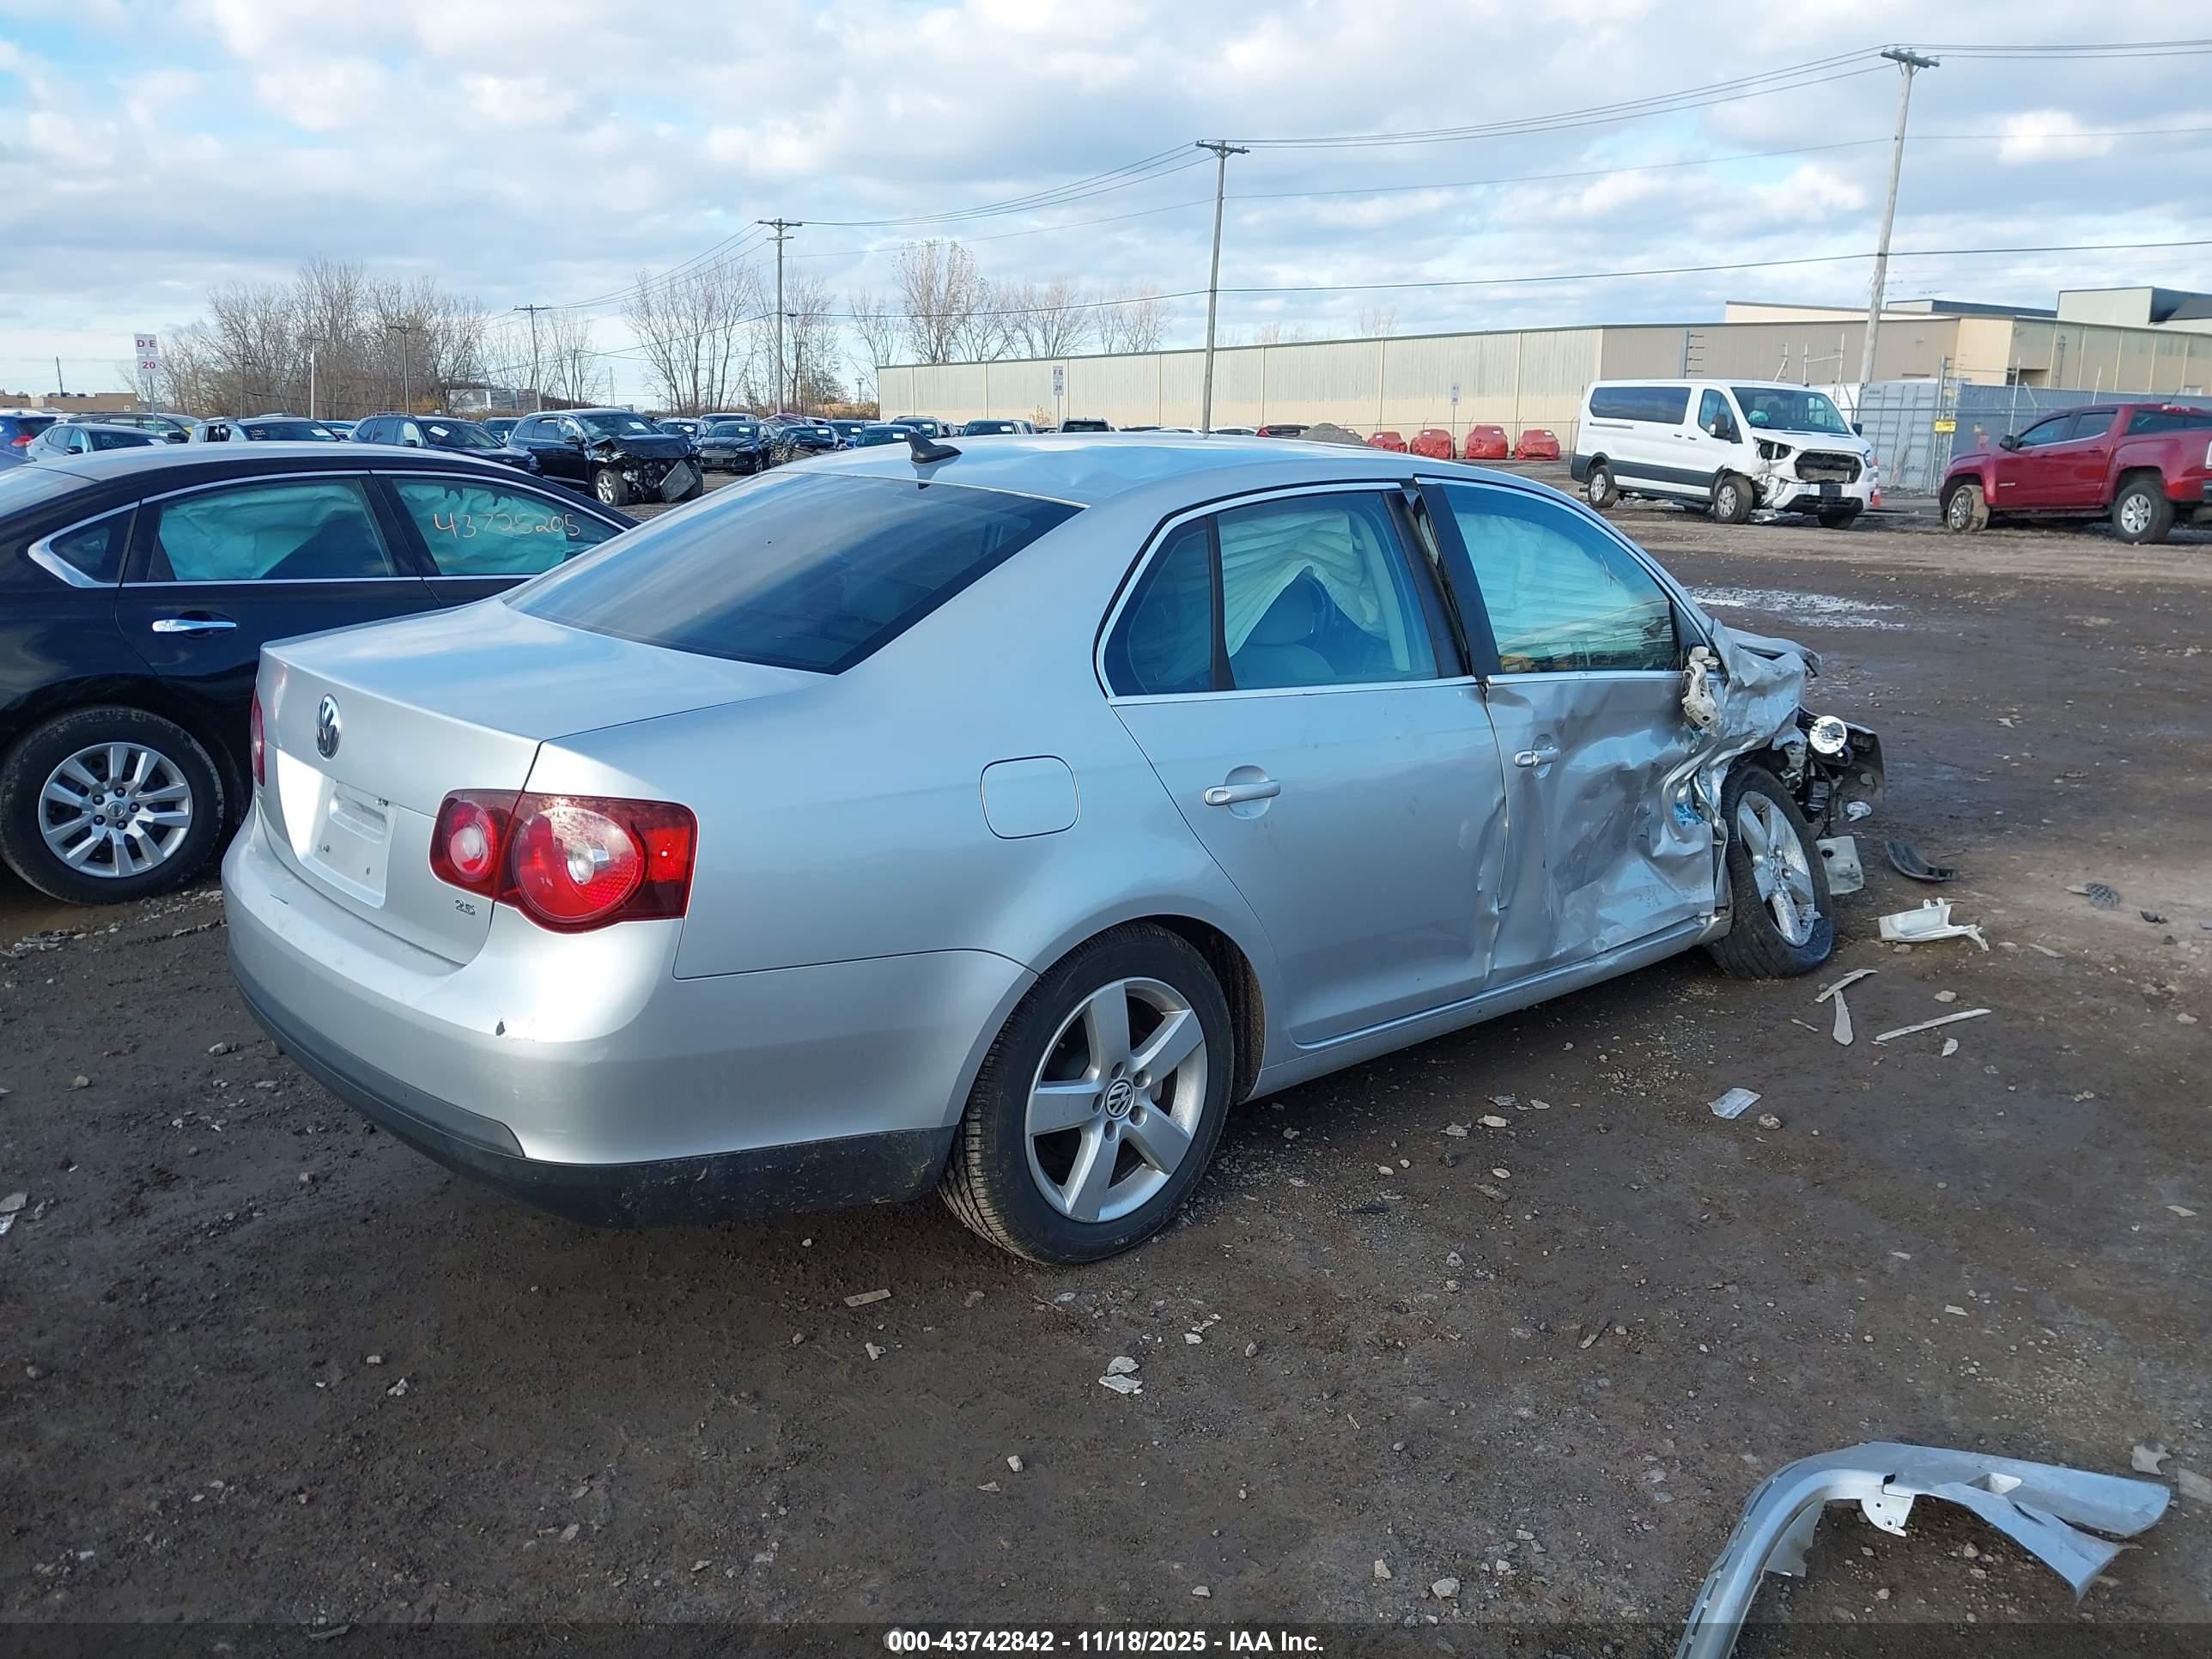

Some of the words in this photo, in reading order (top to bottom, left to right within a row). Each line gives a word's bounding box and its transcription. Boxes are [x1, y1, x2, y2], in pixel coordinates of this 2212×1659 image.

[137, 339, 145, 348] D
[149, 339, 157, 348] E
[142, 361, 156, 369] 20
